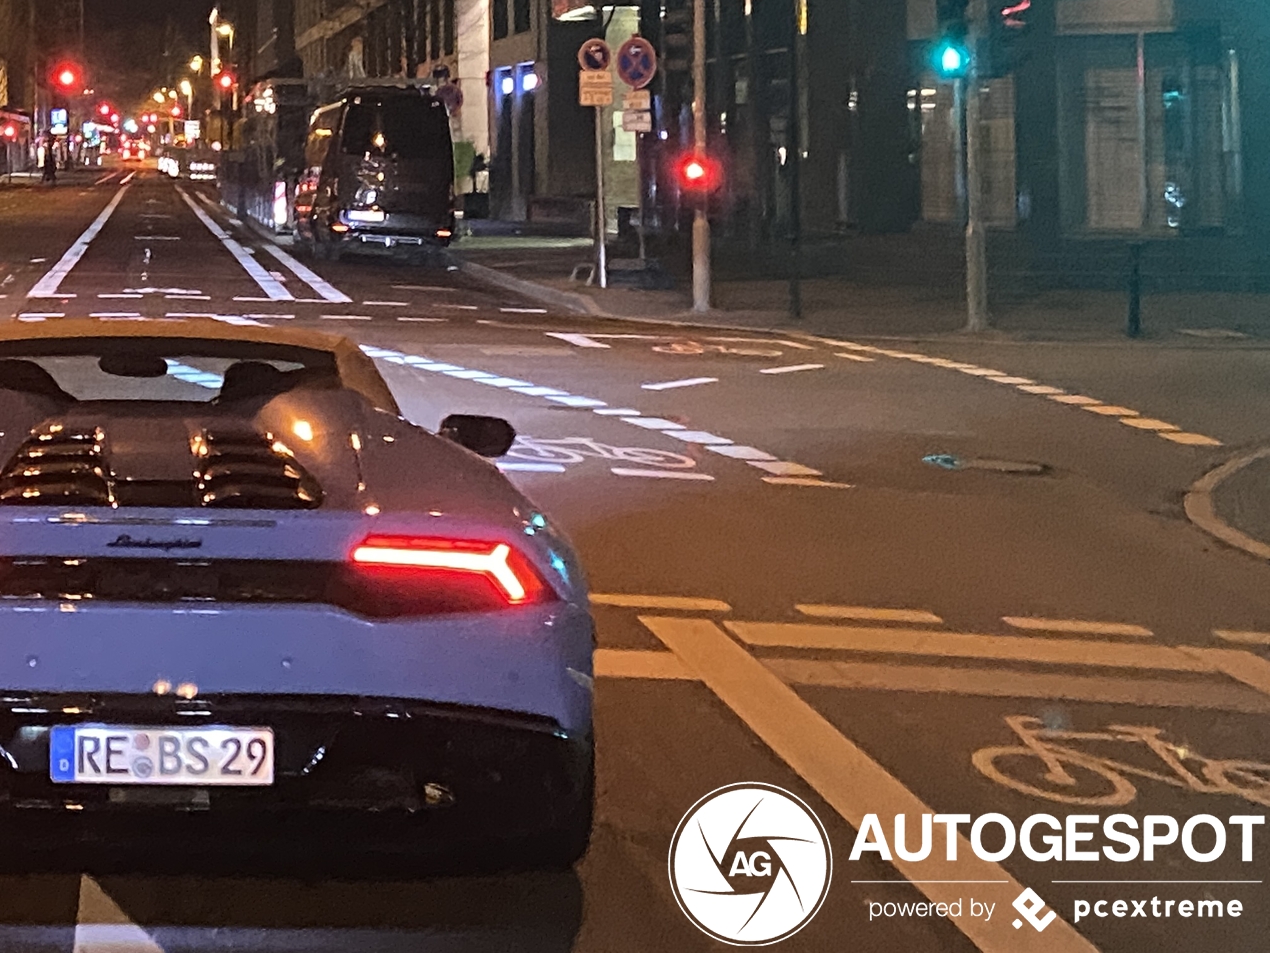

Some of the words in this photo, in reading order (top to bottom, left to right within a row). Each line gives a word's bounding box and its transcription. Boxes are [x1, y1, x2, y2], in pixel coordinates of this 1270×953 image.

[77, 735, 129, 775] RE
[158, 735, 210, 775] BS
[220, 736, 267, 775] 29
